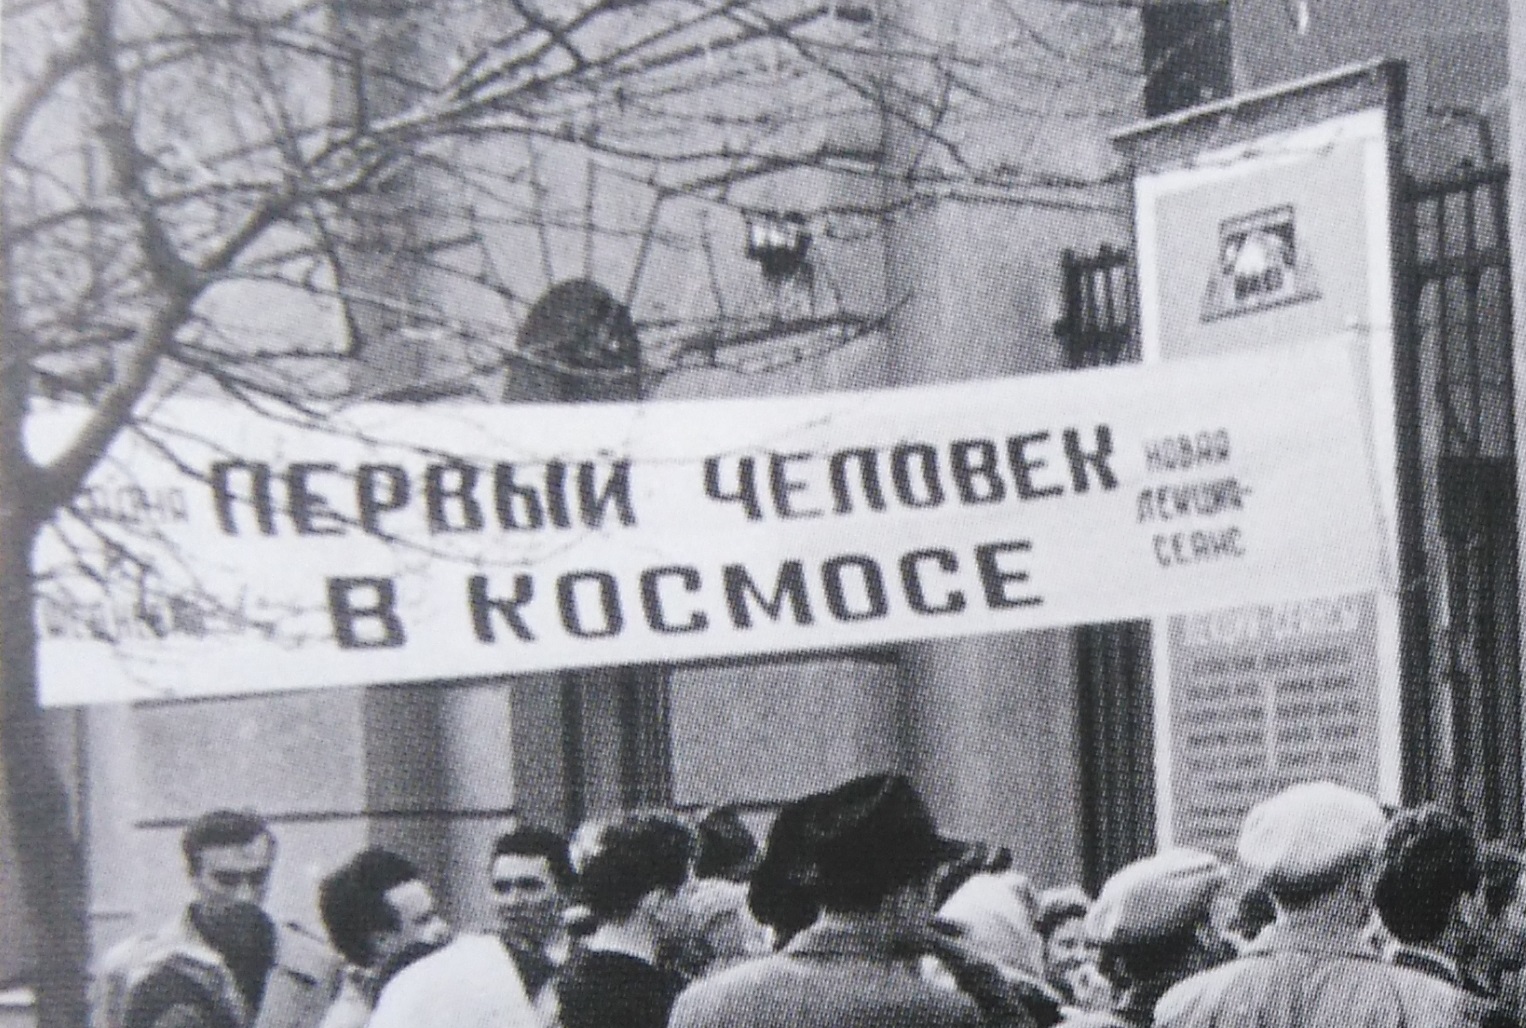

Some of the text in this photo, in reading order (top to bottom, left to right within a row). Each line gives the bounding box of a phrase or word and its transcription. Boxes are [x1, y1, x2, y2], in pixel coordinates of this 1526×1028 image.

[211, 449, 637, 536] ПЕРВЫЙ
[702, 423, 1119, 521] ЧЕЛОВЕК
[1145, 428, 1231, 472] НОВАЯ
[1153, 527, 1246, 568] СЕАНС
[327, 540, 1045, 649] В КОСМОСЕ
